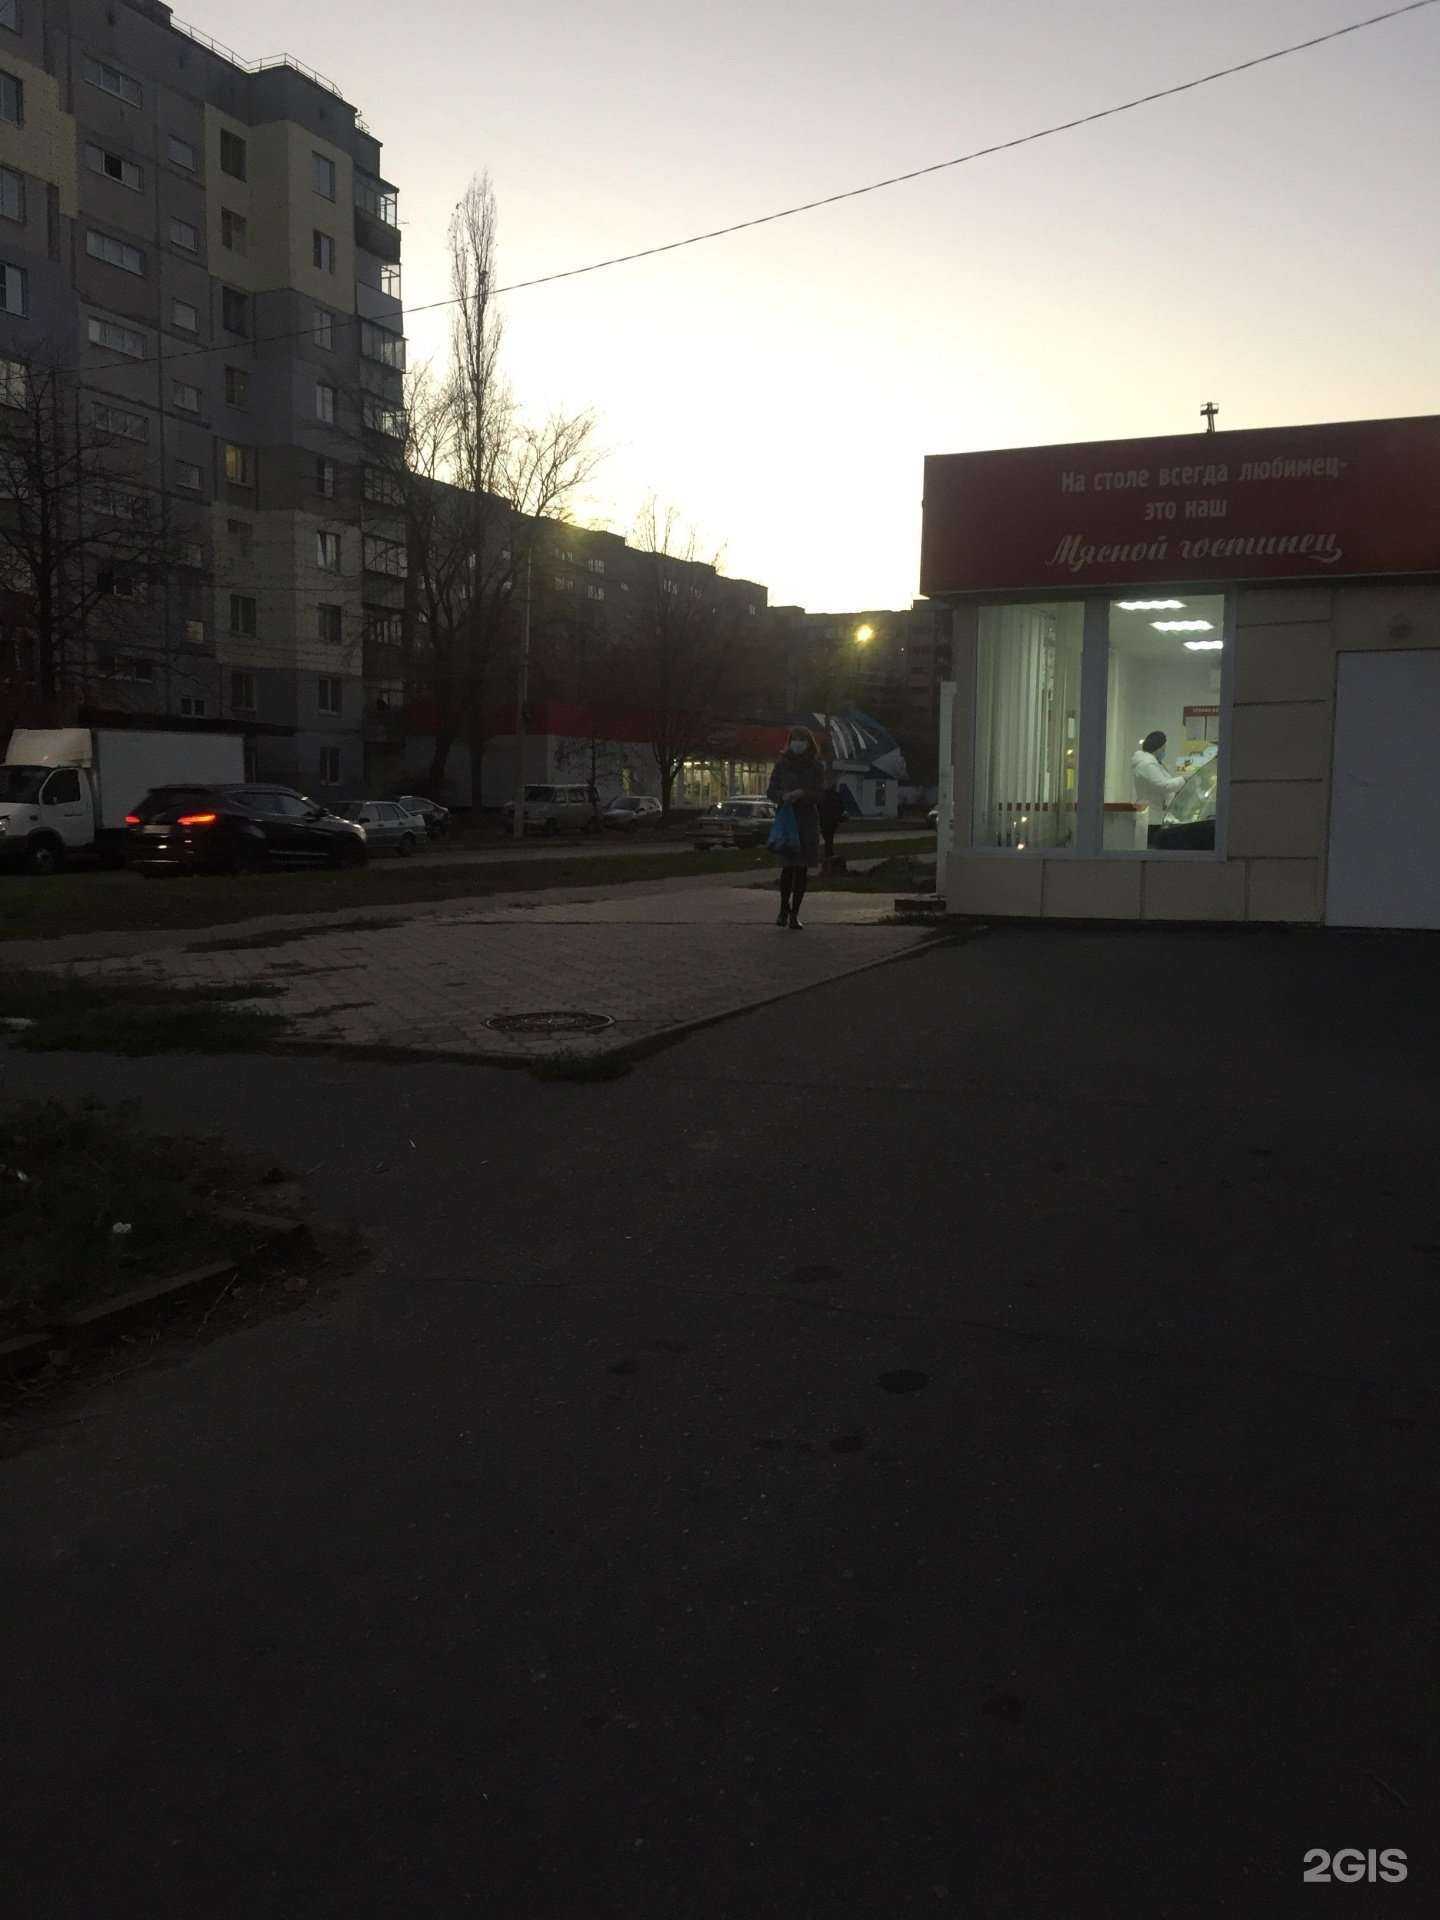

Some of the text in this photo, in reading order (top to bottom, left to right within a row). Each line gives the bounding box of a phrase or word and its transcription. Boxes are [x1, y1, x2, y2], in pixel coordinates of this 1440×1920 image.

[1061, 470, 1086, 494] На
[1093, 466, 1149, 491] столе
[1159, 461, 1229, 487] всегда
[1144, 497, 1229, 521] это наш
[1044, 531, 1344, 573] Мясной гостинец
